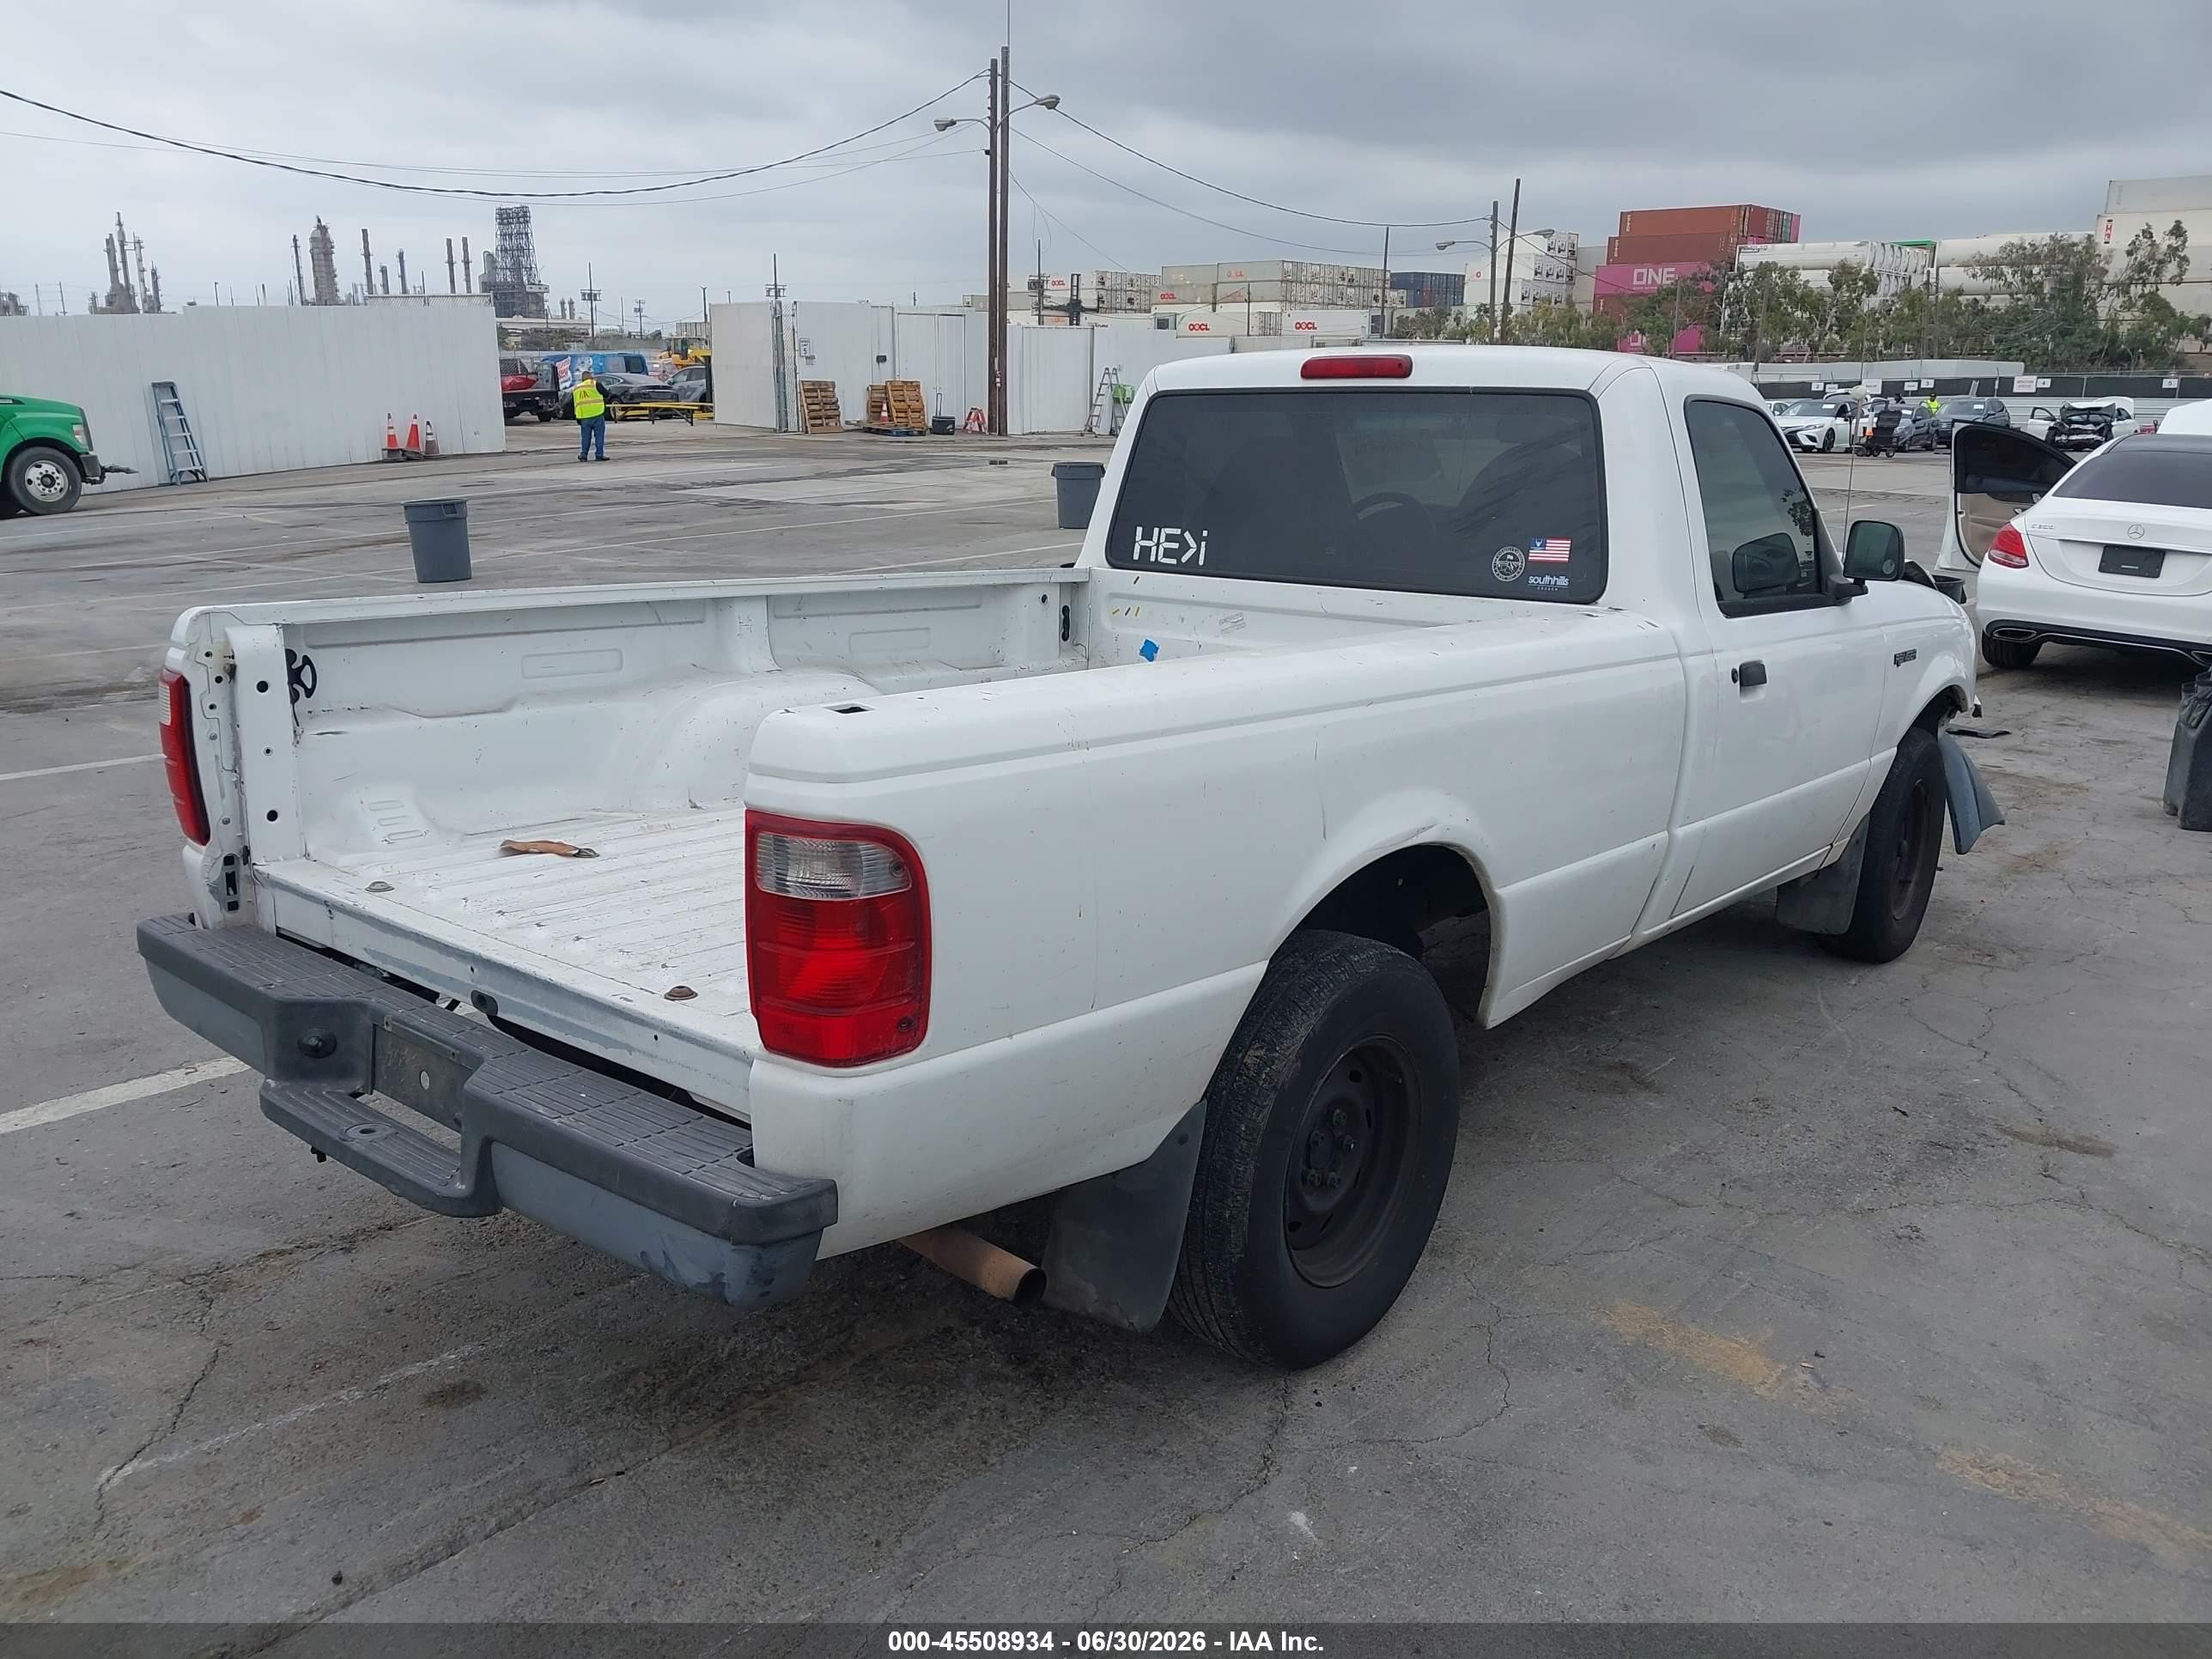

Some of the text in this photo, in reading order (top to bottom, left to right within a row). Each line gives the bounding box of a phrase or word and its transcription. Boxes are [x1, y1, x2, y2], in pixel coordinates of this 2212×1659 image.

[1633, 268, 1677, 285] ONE
[1188, 323, 1210, 331] OOCL
[1295, 322, 1318, 331] OOCL
[1528, 574, 1570, 586] southhills
